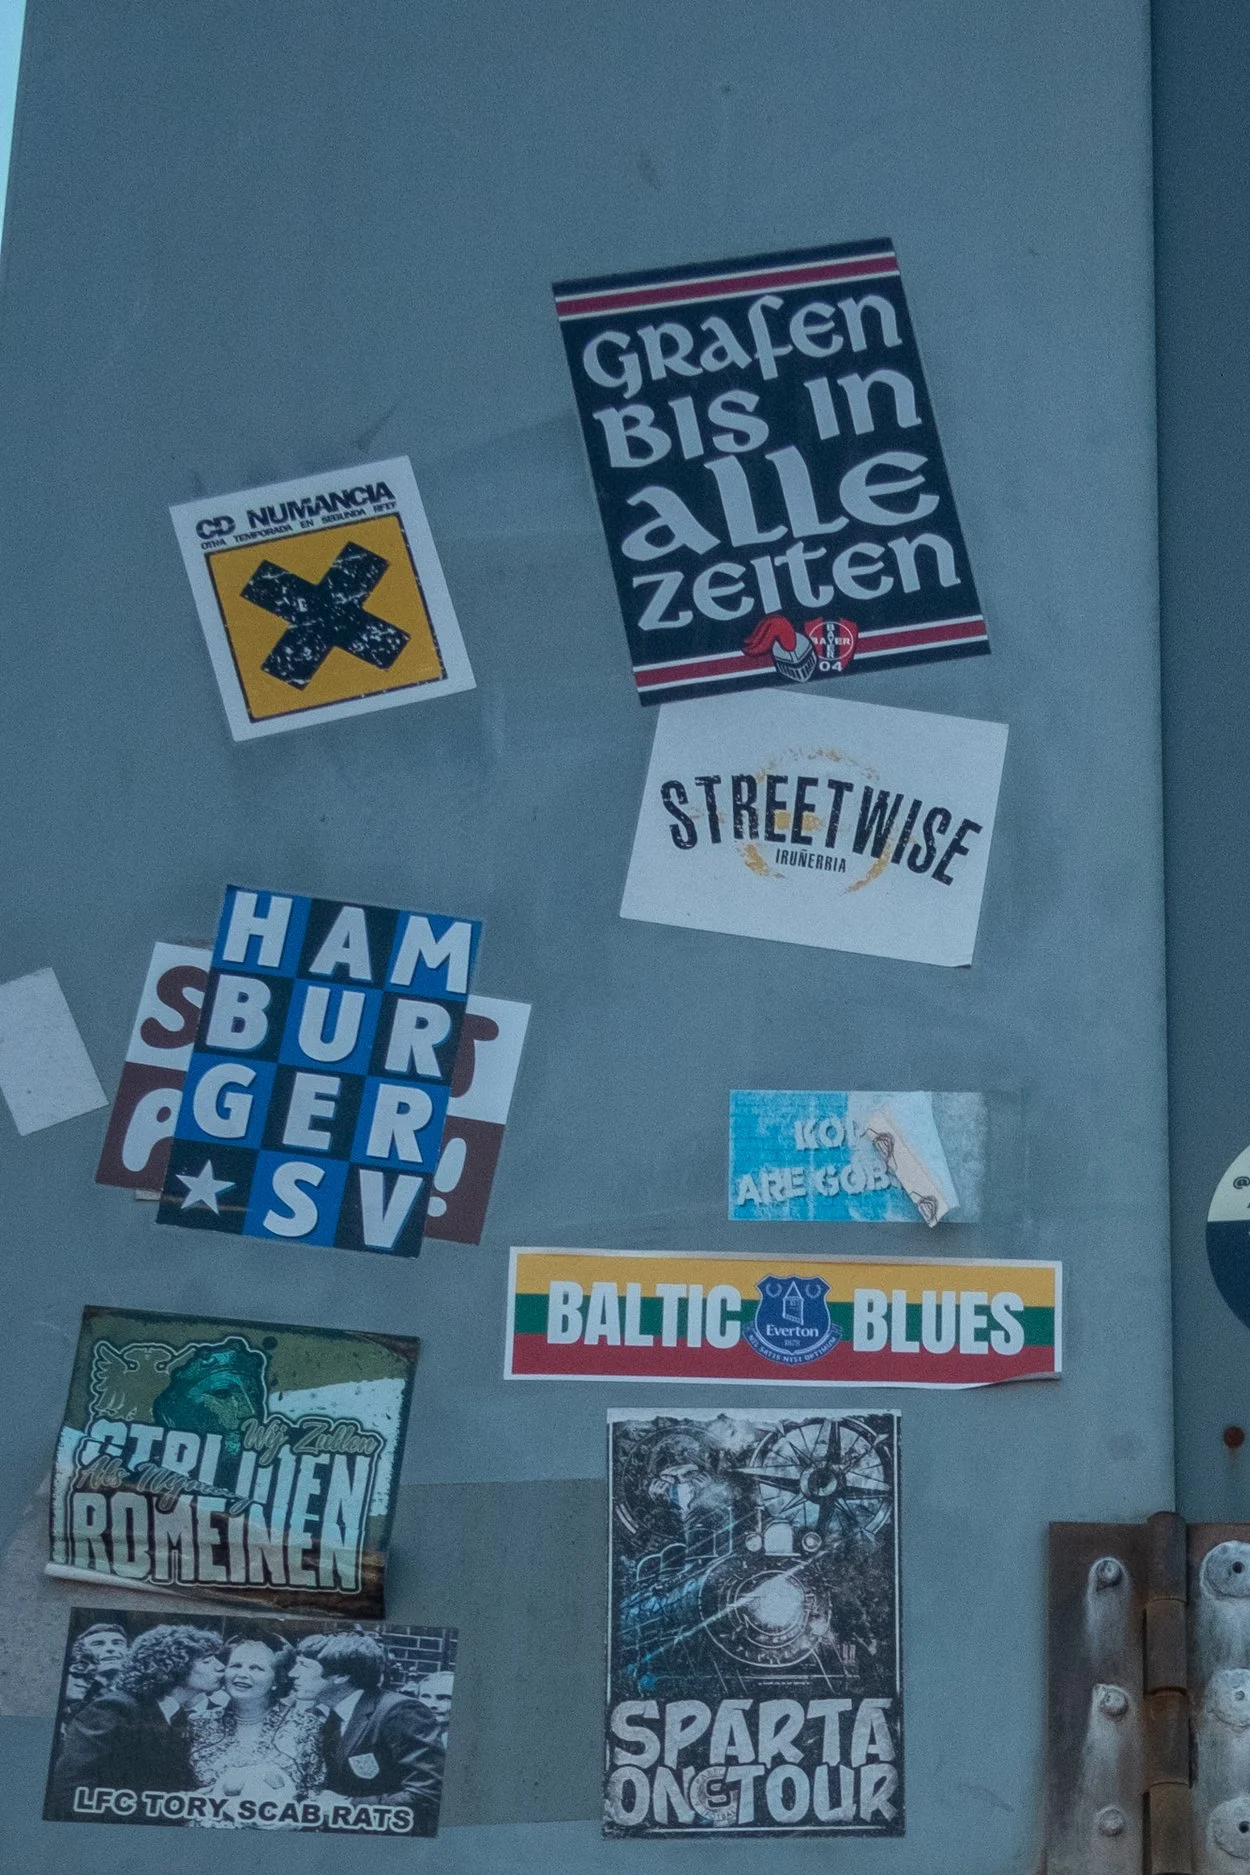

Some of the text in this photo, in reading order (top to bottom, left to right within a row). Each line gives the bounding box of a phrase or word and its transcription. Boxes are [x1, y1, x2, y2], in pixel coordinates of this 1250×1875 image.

[195, 481, 397, 540] CD NUMANCIA
[233, 524, 294, 543] TEMPORADA
[300, 519, 315, 530] EN
[819, 660, 843, 673] 04
[661, 773, 984, 886] STREETWISE
[775, 847, 848, 874] IRUÑERRIA
[221, 890, 473, 995] HAM
[205, 973, 452, 1079] BUR
[192, 1062, 434, 1164] GER
[263, 1160, 425, 1250] SV
[737, 1164, 807, 1207] ARE
[547, 1280, 1026, 1357] BALTIC BLUES
[766, 1323, 820, 1338] Everton
[70, 1491, 361, 1590] ROMEINEN
[610, 1698, 897, 1768] SPARTA
[73, 1785, 415, 1833] LFC TORY SCAB RATS
[724, 1764, 900, 1826] TOUR
